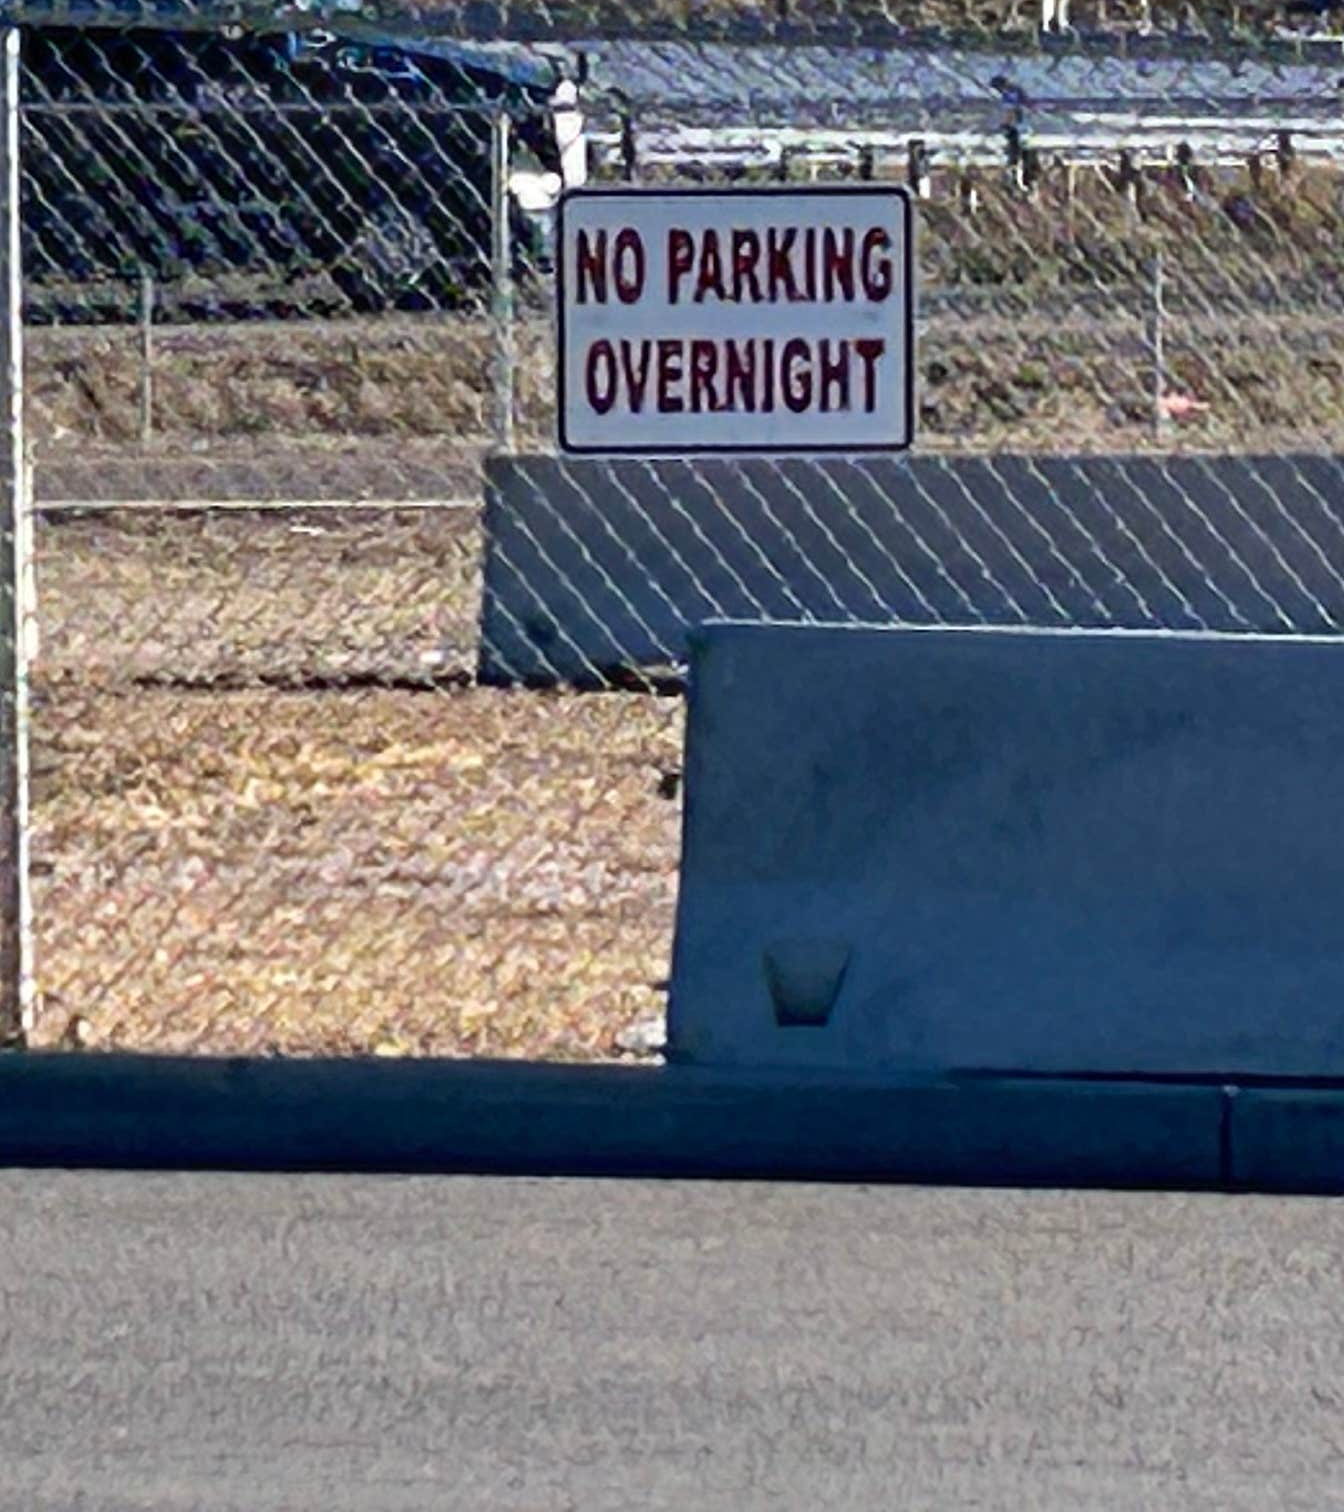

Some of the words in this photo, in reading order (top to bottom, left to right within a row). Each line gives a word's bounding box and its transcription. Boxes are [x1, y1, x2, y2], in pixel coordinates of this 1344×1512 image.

[575, 226, 645, 304] NO
[667, 226, 894, 304] PARKING
[586, 337, 886, 415] OVERNIGHT
